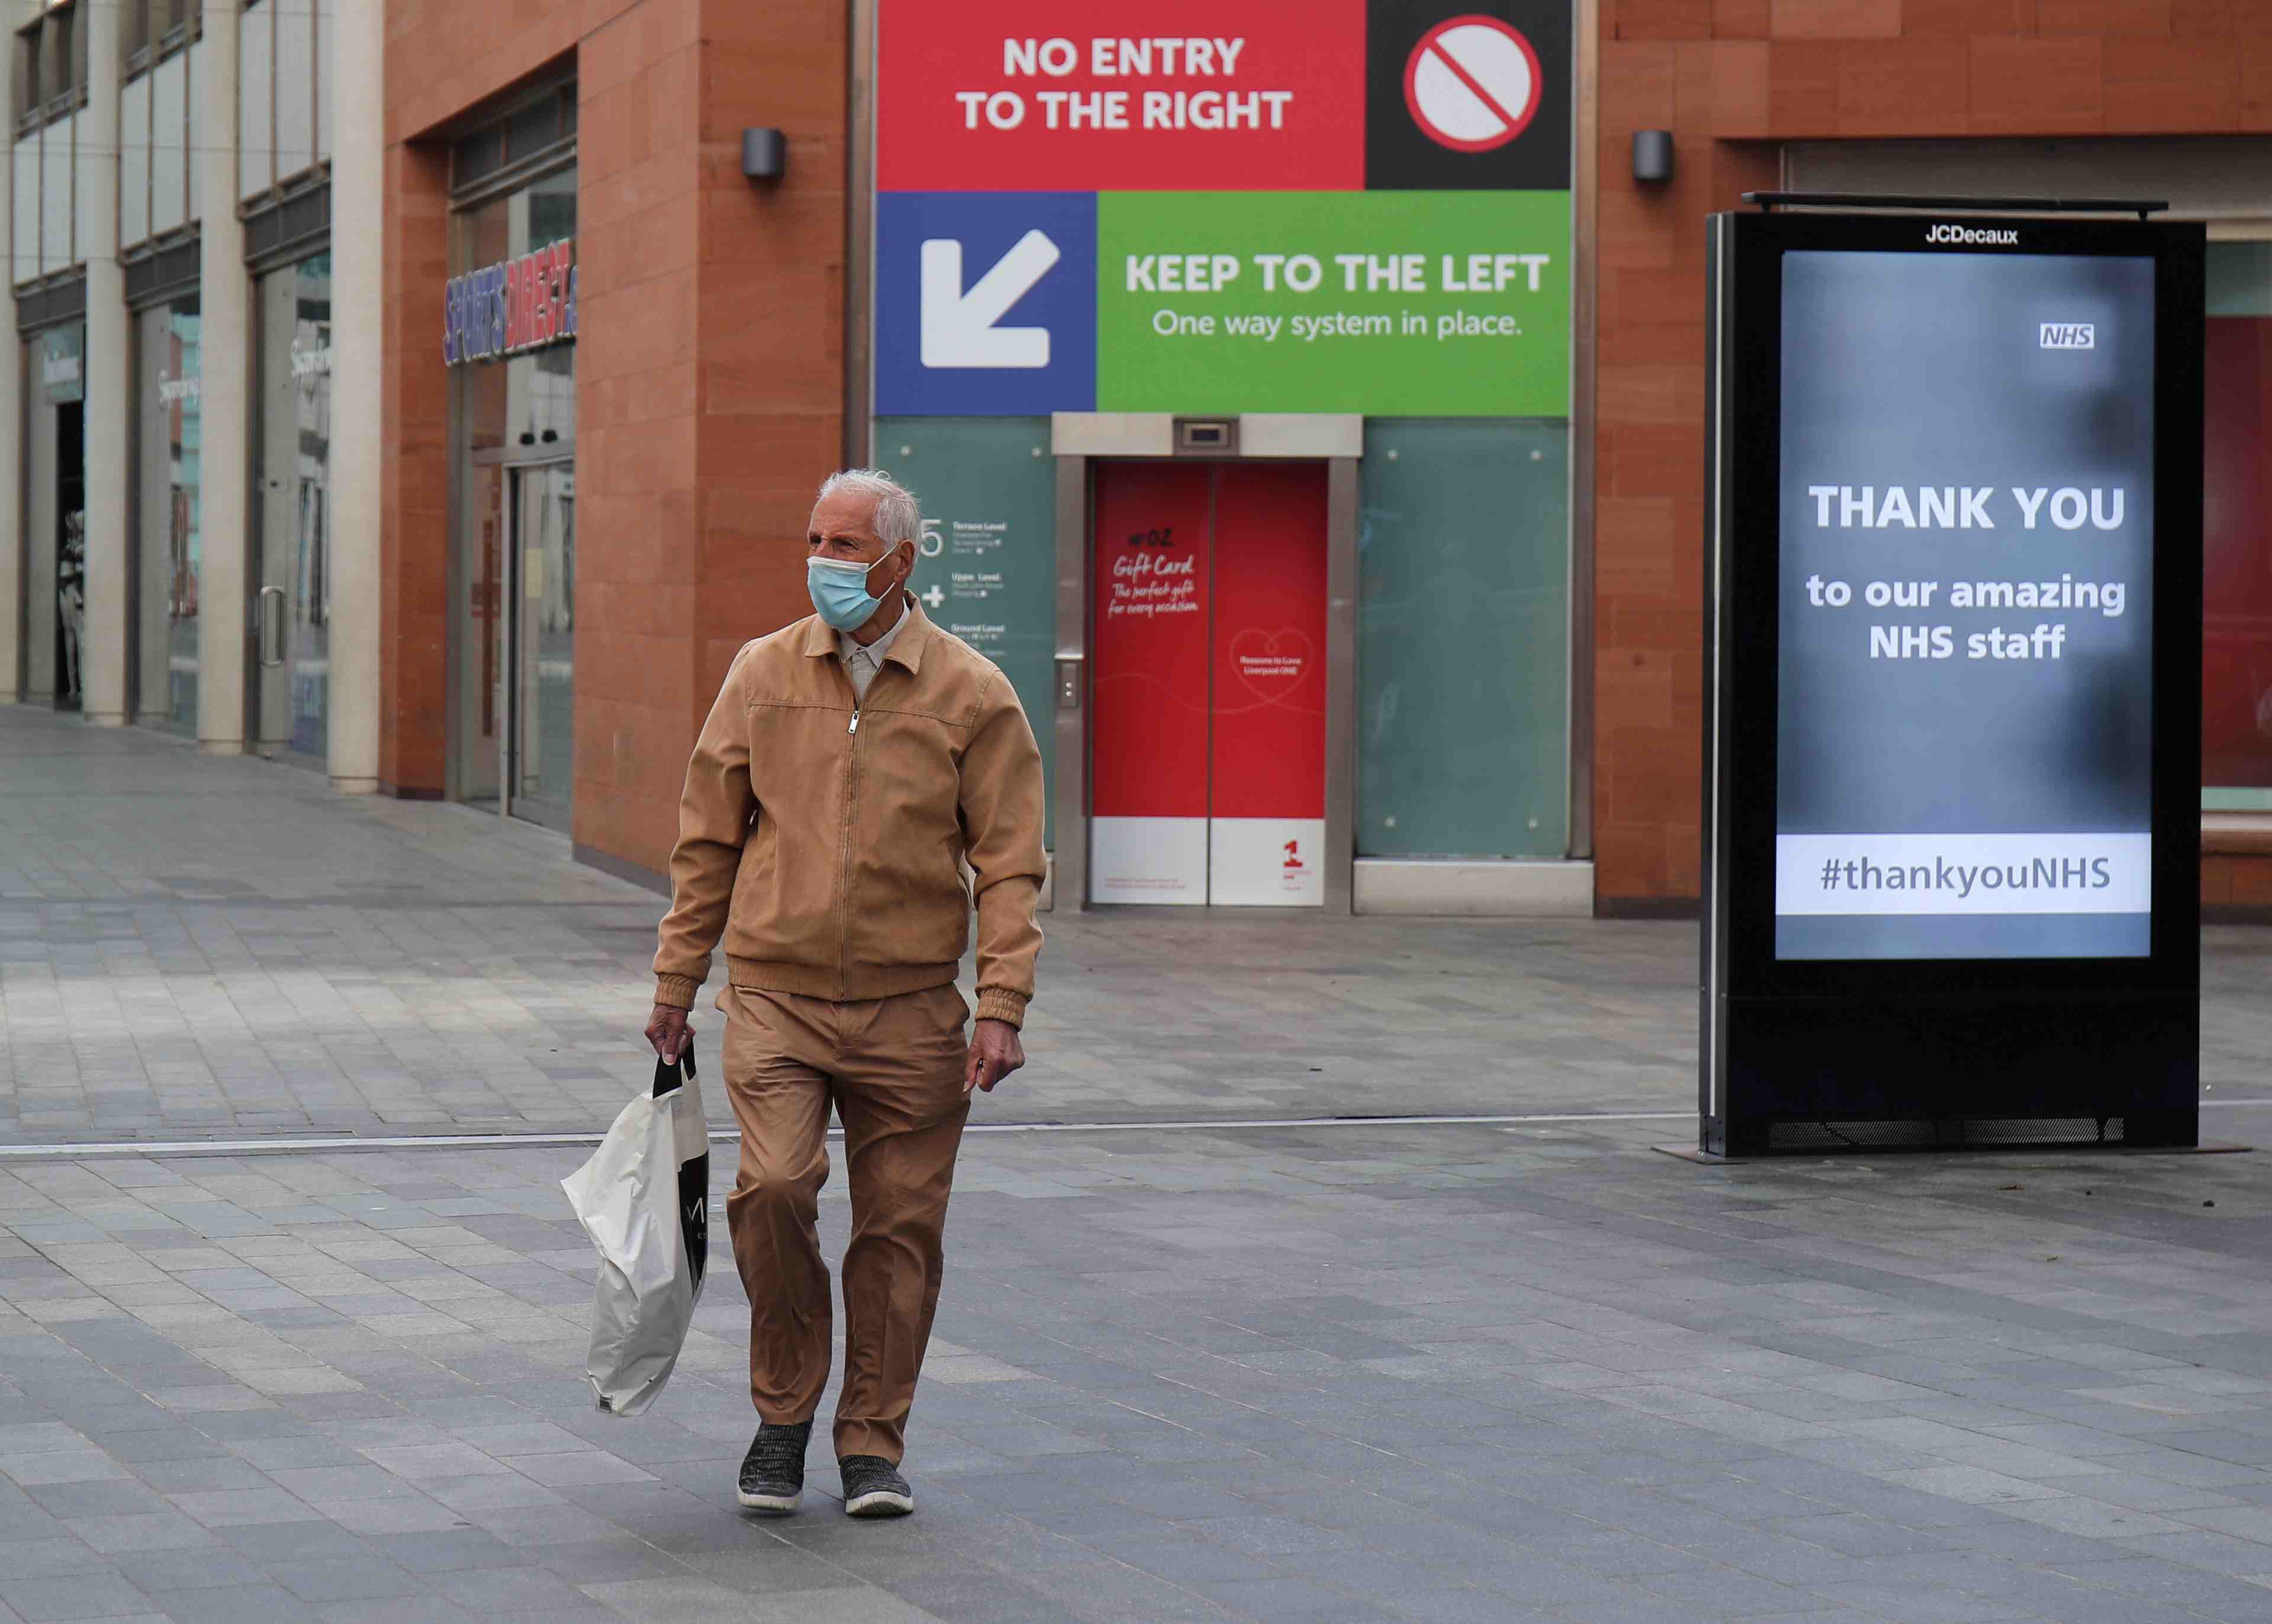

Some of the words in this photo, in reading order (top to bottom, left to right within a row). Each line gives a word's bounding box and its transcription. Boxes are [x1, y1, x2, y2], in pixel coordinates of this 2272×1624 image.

[1003, 37, 1078, 77] NO
[1091, 37, 1245, 76] ENTRY
[955, 91, 1025, 130] TO
[1035, 91, 1129, 130] THE
[1143, 90, 1293, 130] RIGHT
[1925, 224, 2019, 245] JCDecaux
[1125, 254, 1240, 292] KEEP
[1252, 253, 1323, 292] TO
[1334, 254, 1427, 292] THE
[1441, 253, 1551, 292] LEFT
[1152, 309, 1216, 336] One
[1224, 315, 1283, 342] way
[1290, 311, 1393, 342] system
[1401, 309, 1428, 335] in
[1437, 309, 1522, 341] place.
[2042, 327, 2092, 346] NHS
[1808, 486, 1995, 529] THANK
[2012, 487, 2124, 530] YOU
[1113, 551, 1151, 584] Gift
[1154, 554, 1194, 576] Card
[1112, 582, 1131, 597] The
[1131, 580, 1170, 600] perfect
[1169, 578, 1195, 602] gift
[1806, 574, 1851, 606] to
[1864, 581, 1938, 607] our
[1950, 573, 2125, 616] amazing
[1870, 625, 1954, 658] NHS
[1967, 624, 2066, 659] staff
[1820, 855, 2110, 899] #thankyouNHS
